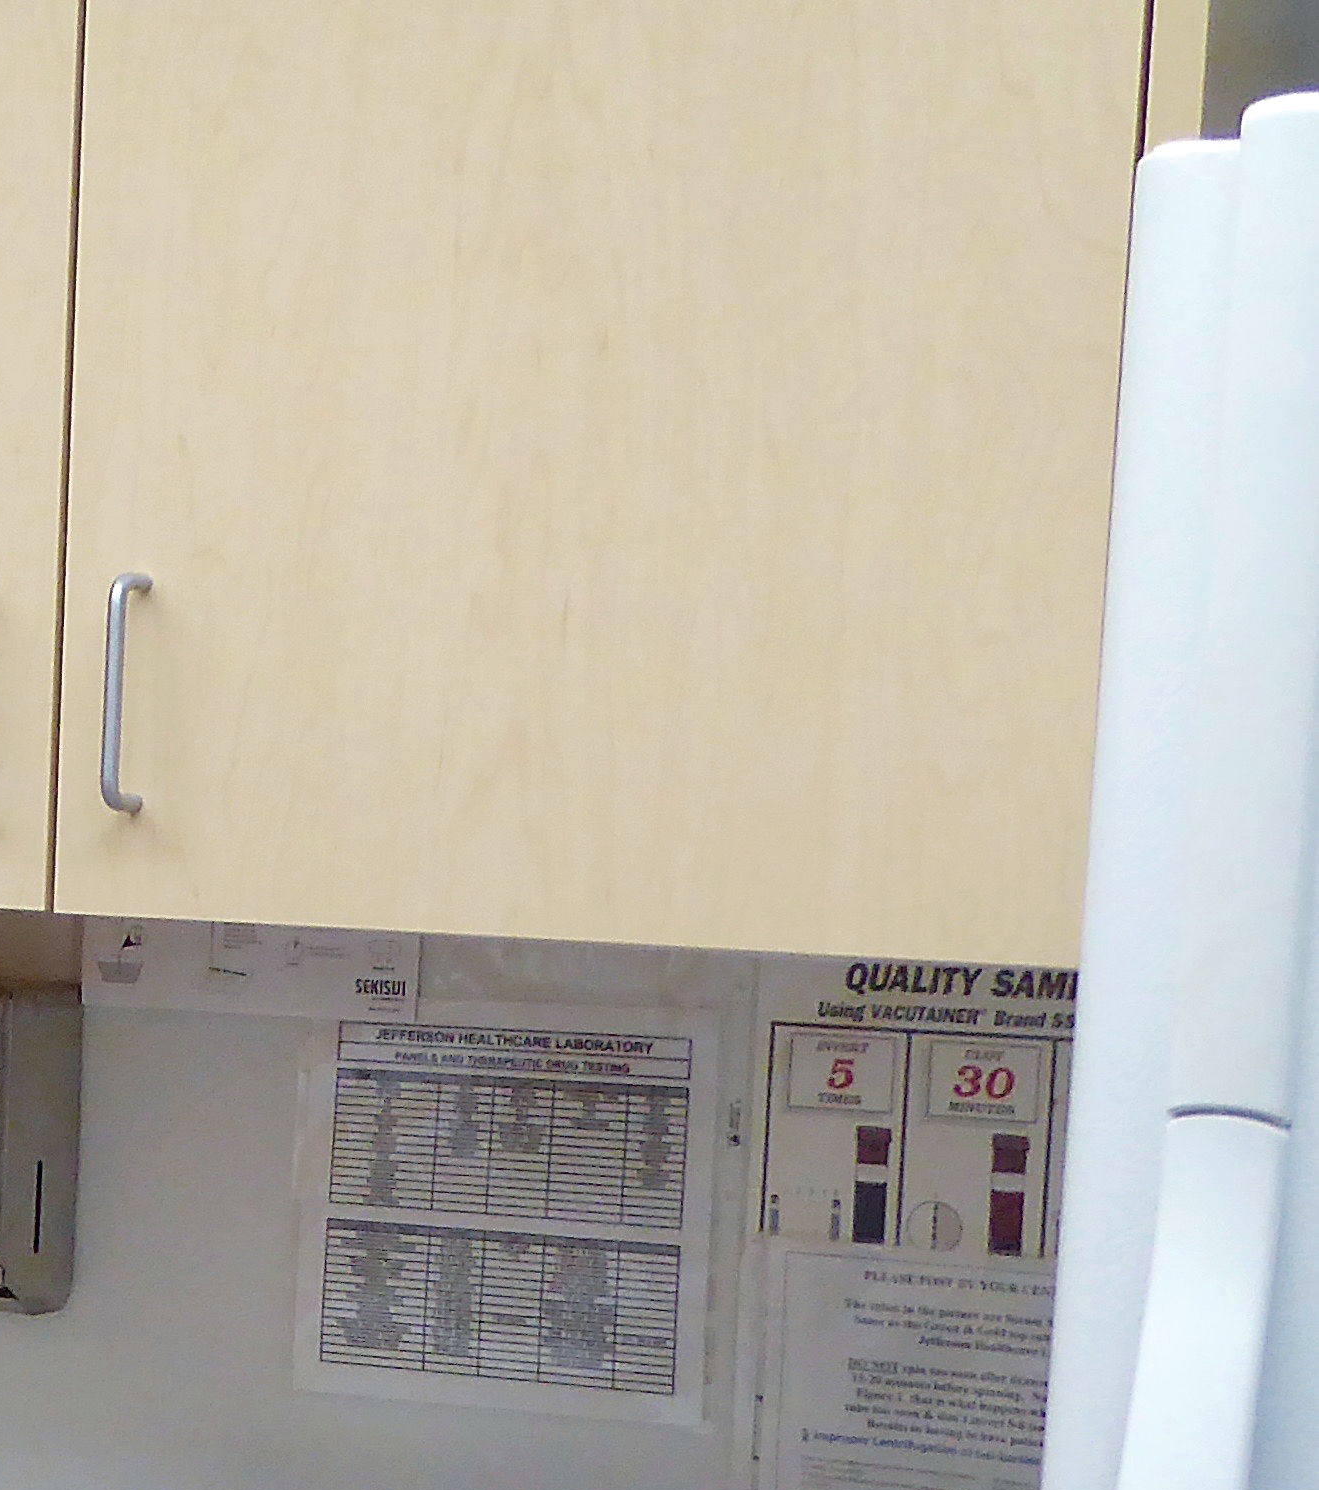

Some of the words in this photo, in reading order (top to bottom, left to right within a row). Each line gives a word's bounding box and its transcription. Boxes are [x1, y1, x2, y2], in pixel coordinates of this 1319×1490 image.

[356, 978, 405, 997] SEKISUI
[846, 963, 982, 996] QUALITY
[817, 1001, 865, 1022] Using
[993, 1010, 1047, 1028] Brand
[375, 1029, 454, 1045] JEFFERSON
[459, 1033, 551, 1049] HEALTHCARE
[556, 1038, 654, 1055] LABORATORY
[395, 1051, 437, 1064] PANELS
[440, 1053, 463, 1065] AND
[467, 1055, 541, 1070] THERAPEUTIC
[827, 1059, 855, 1090] 5
[952, 1065, 1016, 1100] 30
